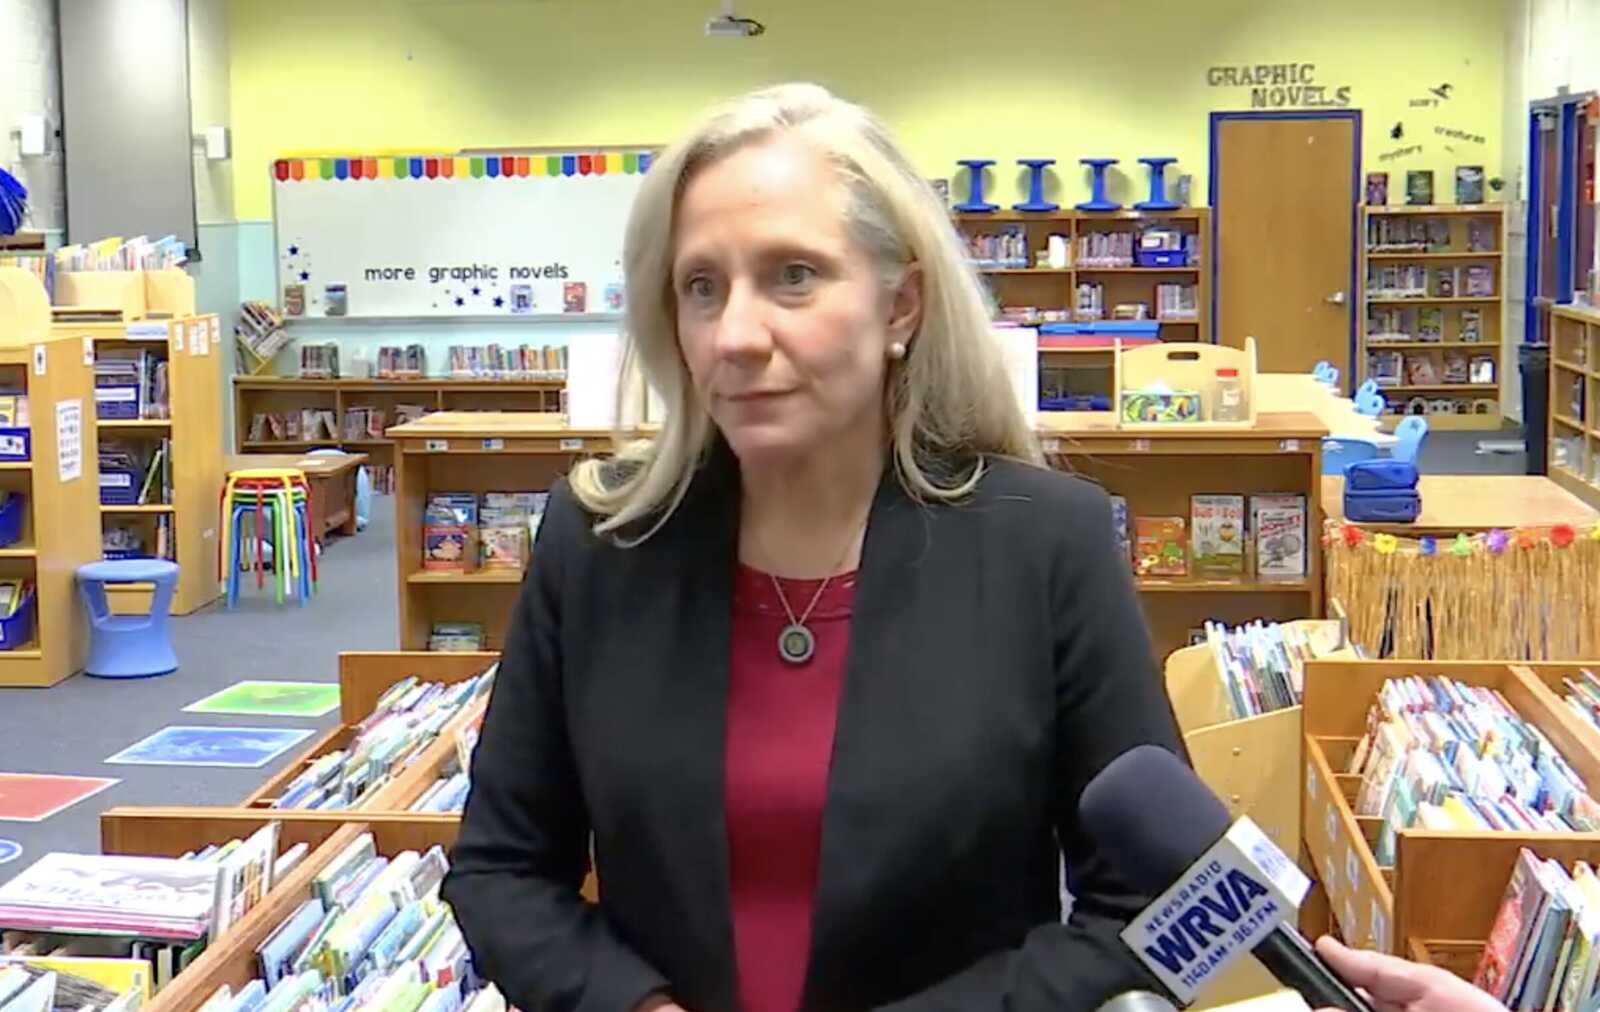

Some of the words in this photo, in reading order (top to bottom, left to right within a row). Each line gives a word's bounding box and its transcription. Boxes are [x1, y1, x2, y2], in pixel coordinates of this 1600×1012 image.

[1251, 86, 1351, 108] NOVELS
[1434, 126, 1486, 144] creatures
[364, 266, 415, 280] more
[428, 264, 498, 283] graphic
[509, 262, 569, 280] novels
[1145, 860, 1222, 933] NEWSRADIO
[1144, 868, 1268, 975] WRVA
